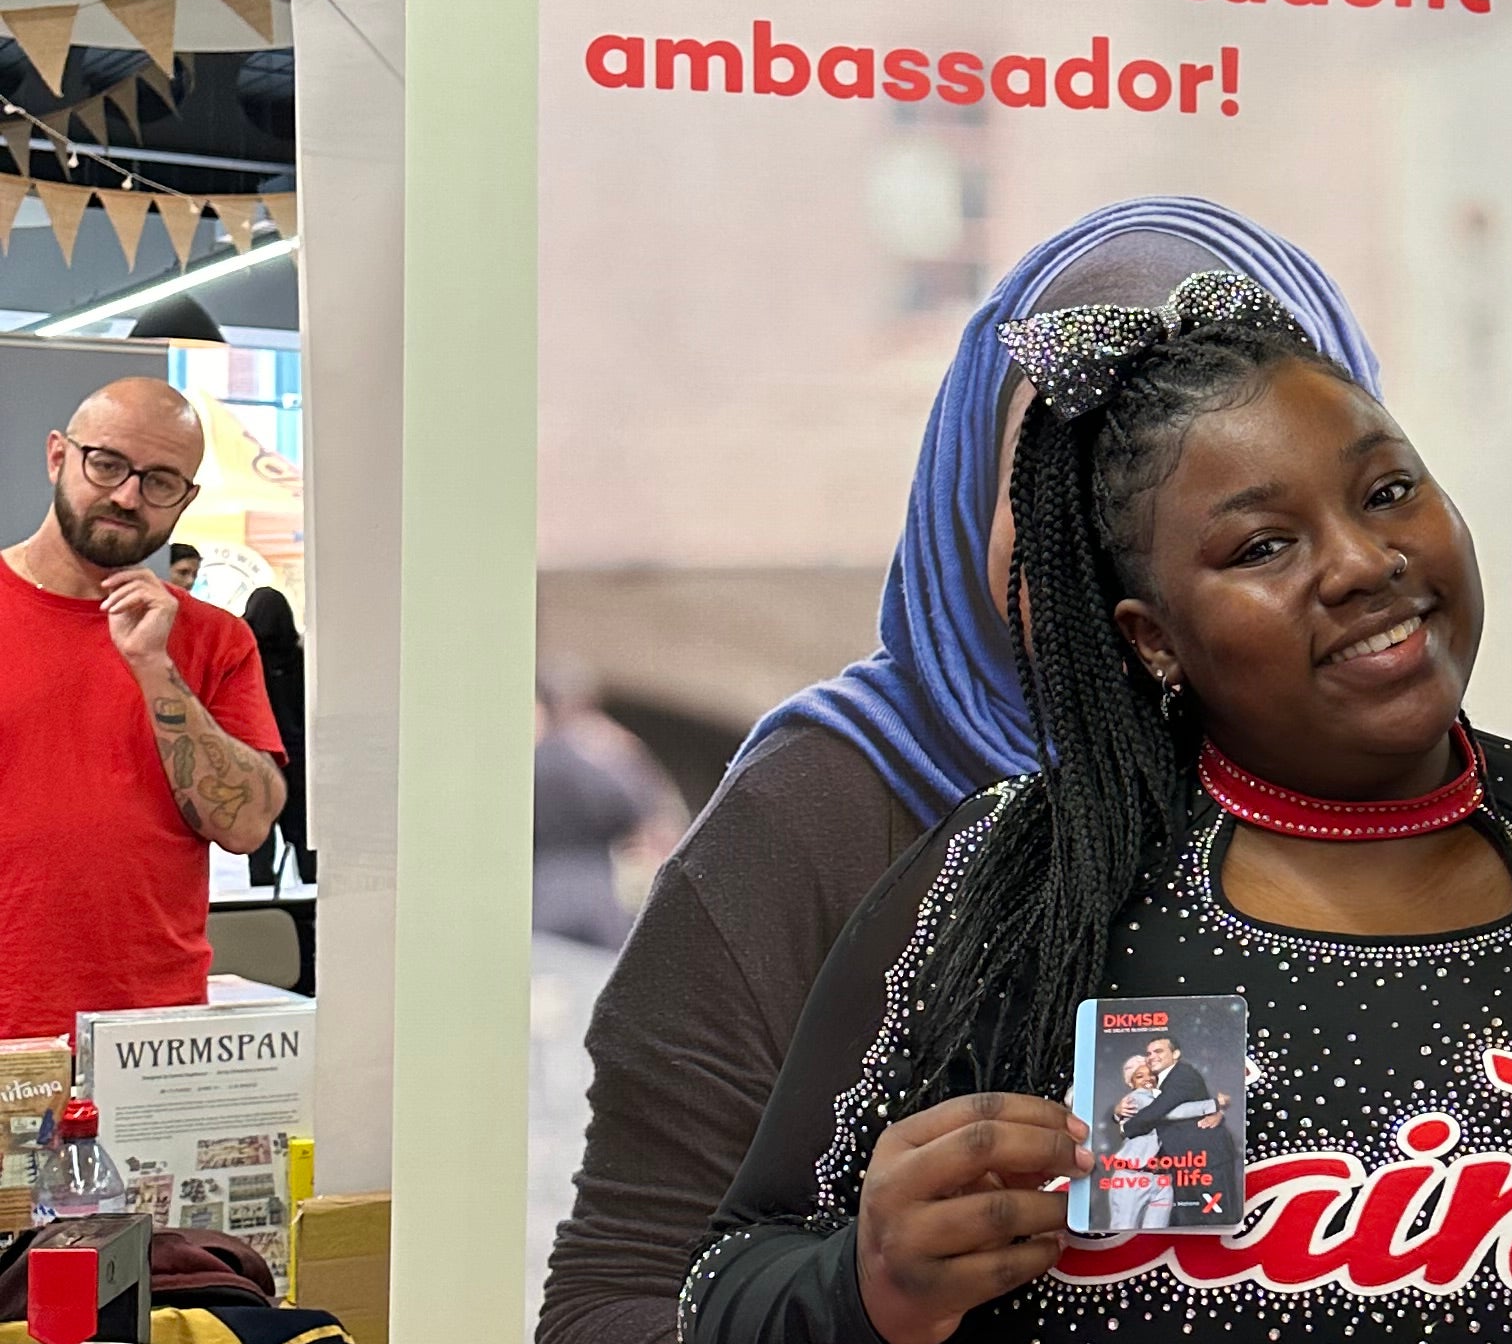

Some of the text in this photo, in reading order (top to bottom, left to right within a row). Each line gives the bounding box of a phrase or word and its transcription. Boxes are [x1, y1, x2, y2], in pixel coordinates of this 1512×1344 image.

[585, 20, 1242, 117] ambassador!
[1103, 1013, 1154, 1027] DKMS
[116, 1030, 299, 1069] WYRMSPAN
[1101, 1151, 1207, 1171] You could
[1099, 1170, 1213, 1190] save a life
